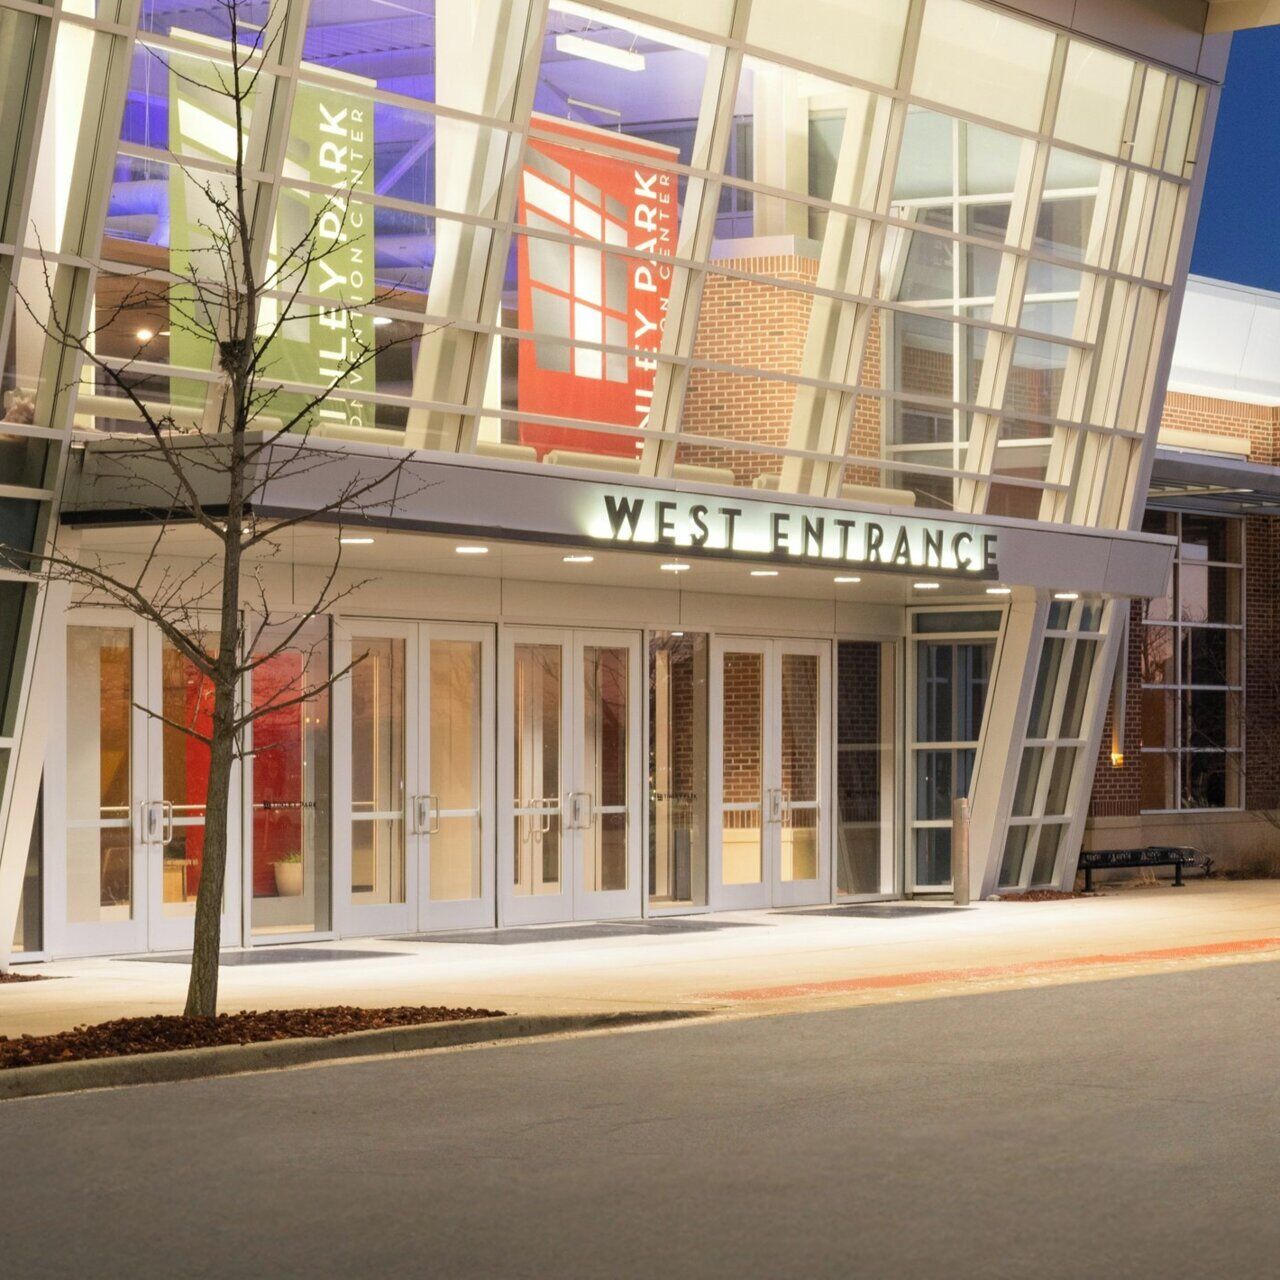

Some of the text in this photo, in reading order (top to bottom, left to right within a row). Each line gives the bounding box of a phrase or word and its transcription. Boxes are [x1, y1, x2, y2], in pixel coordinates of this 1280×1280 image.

[319, 102, 348, 420] INLEY PARK
[634, 169, 658, 292] PARK
[350, 247, 364, 427] ONVENTION
[604, 495, 998, 570] WEST ENTRANCE
